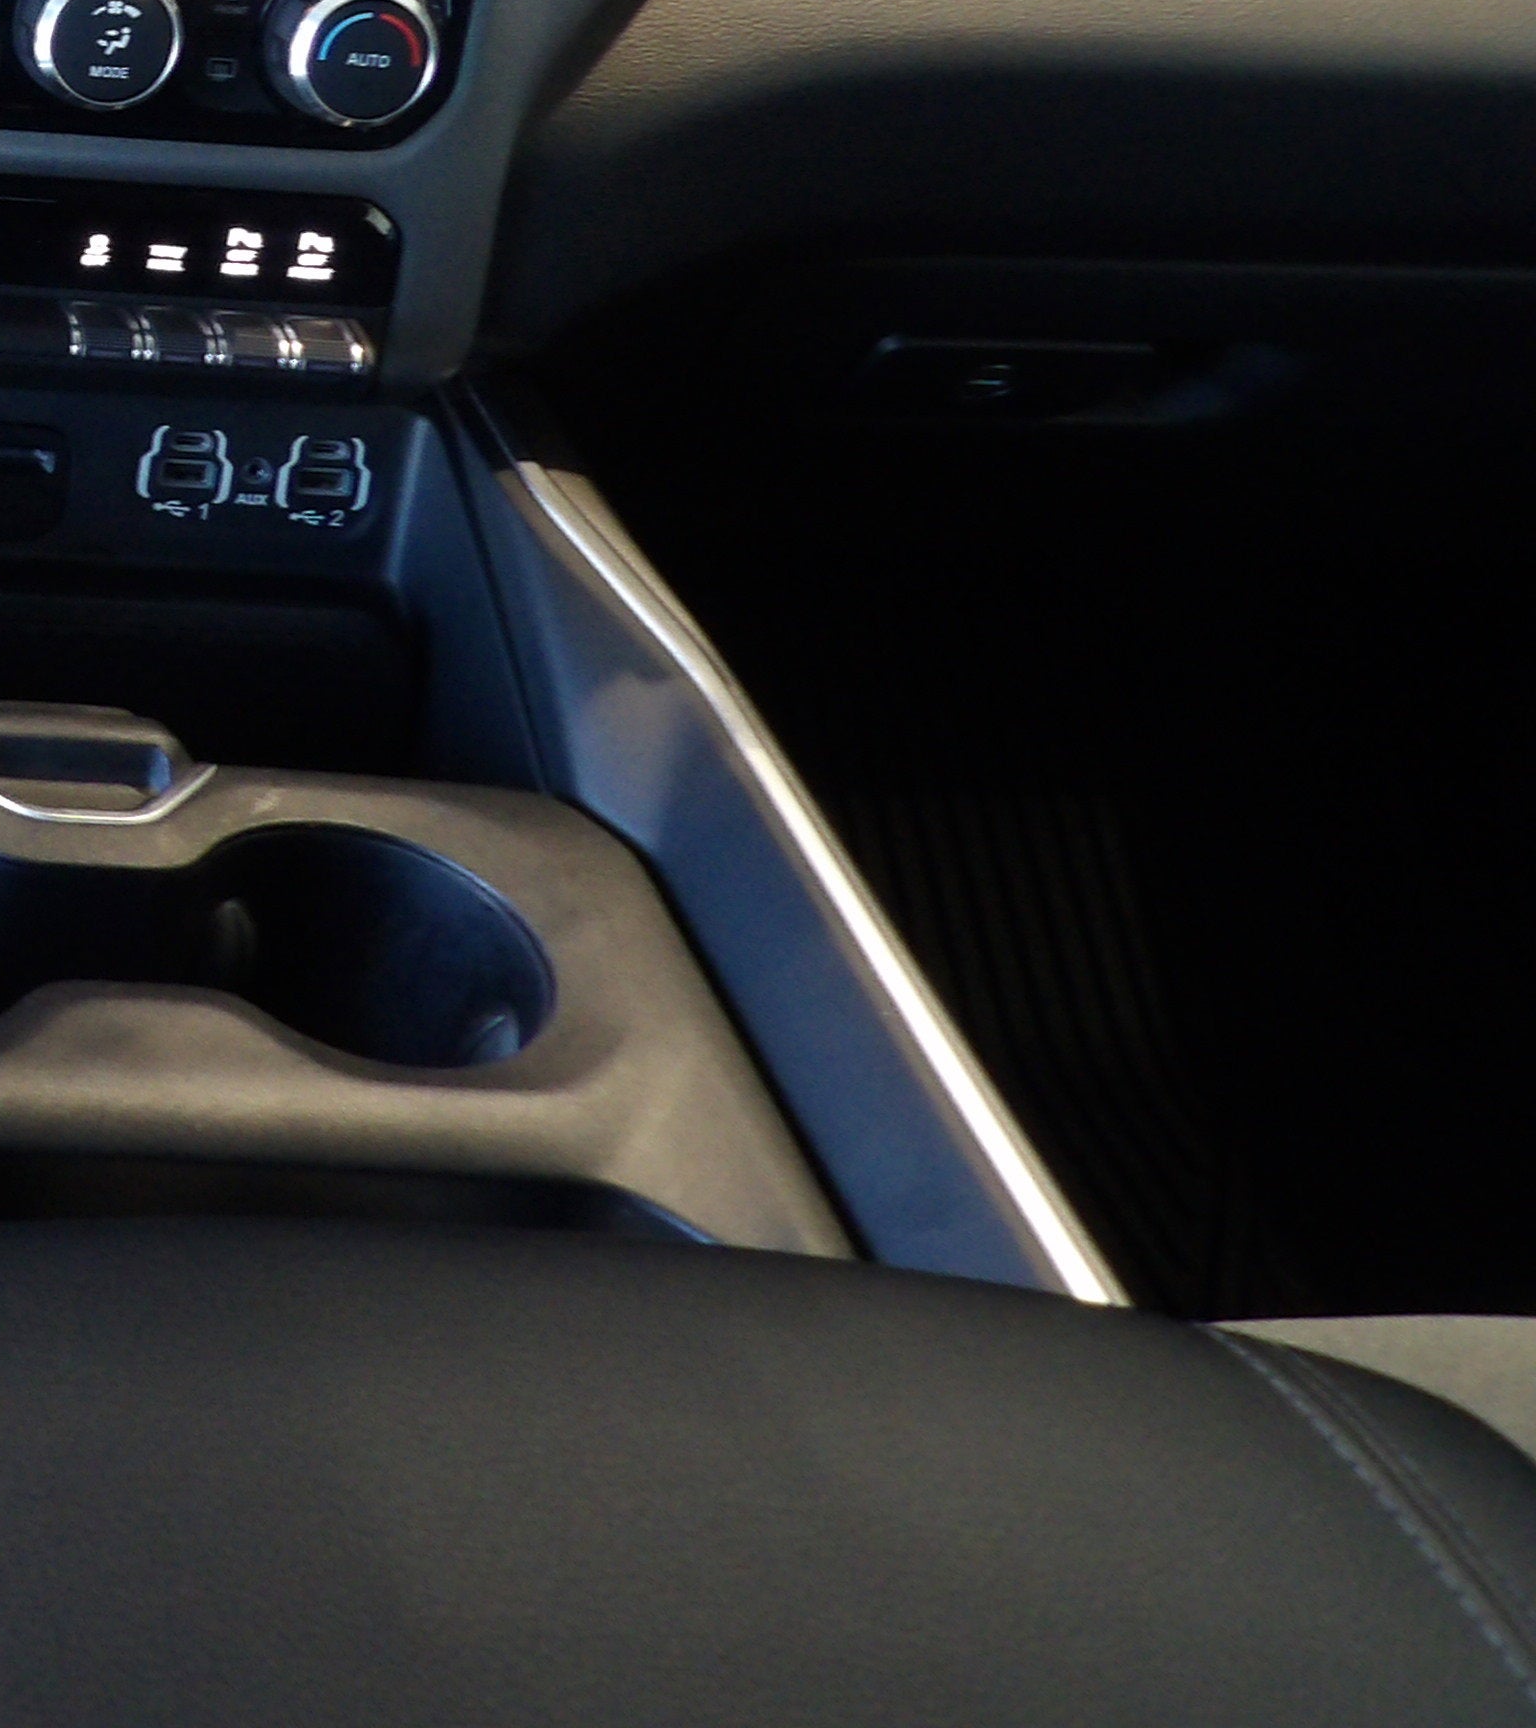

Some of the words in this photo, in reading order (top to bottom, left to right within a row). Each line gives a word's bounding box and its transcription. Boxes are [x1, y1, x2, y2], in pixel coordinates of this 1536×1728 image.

[346, 52, 392, 69] AUTO
[88, 65, 130, 79] MODE
[234, 493, 269, 506] AUX
[198, 503, 210, 520] 1
[328, 510, 345, 527] 2
